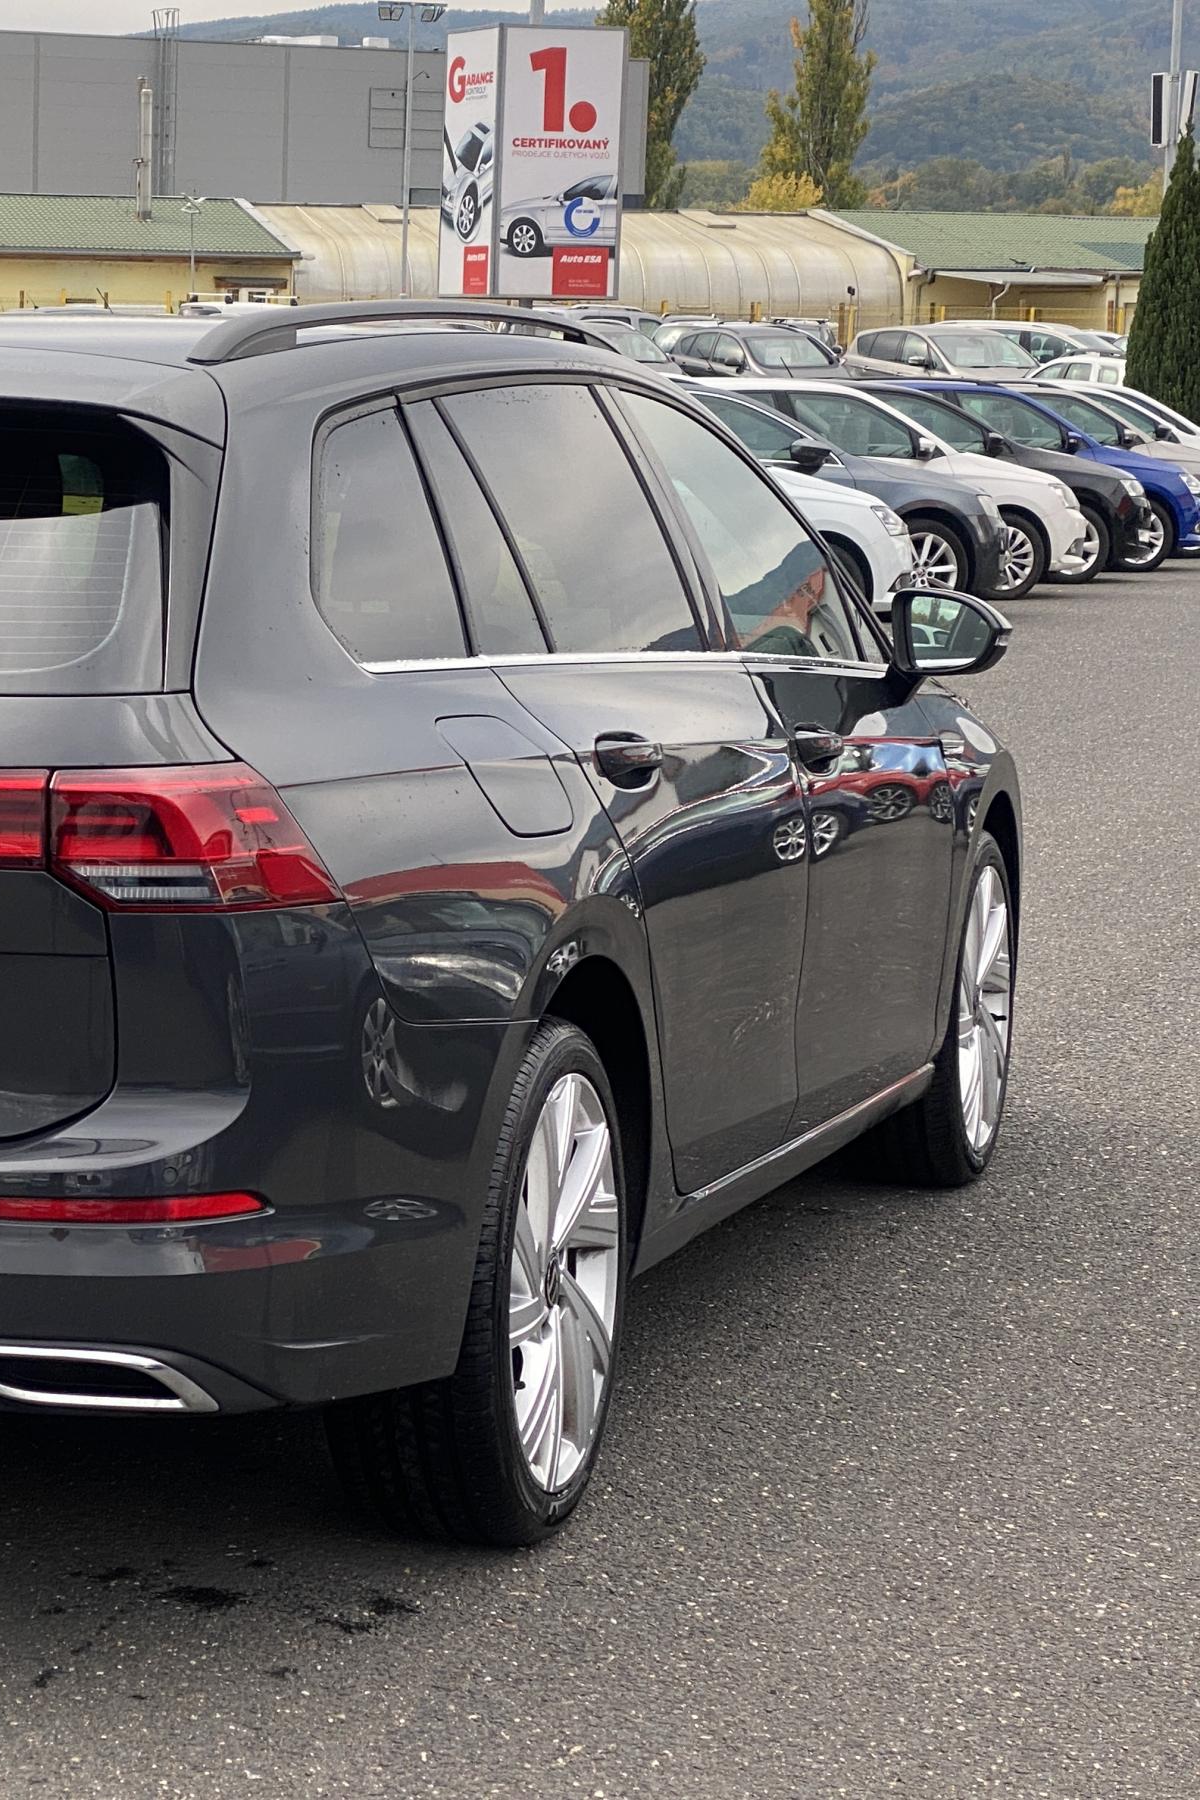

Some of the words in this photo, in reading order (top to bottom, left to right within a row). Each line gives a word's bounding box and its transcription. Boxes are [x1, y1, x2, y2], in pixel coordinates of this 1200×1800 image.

[449, 56, 494, 103] GARANCE
[529, 47, 597, 132] 1.
[512, 137, 610, 150] CERTIFIKOVANÝ
[559, 254, 584, 263] Auto
[583, 255, 602, 263] ESA
